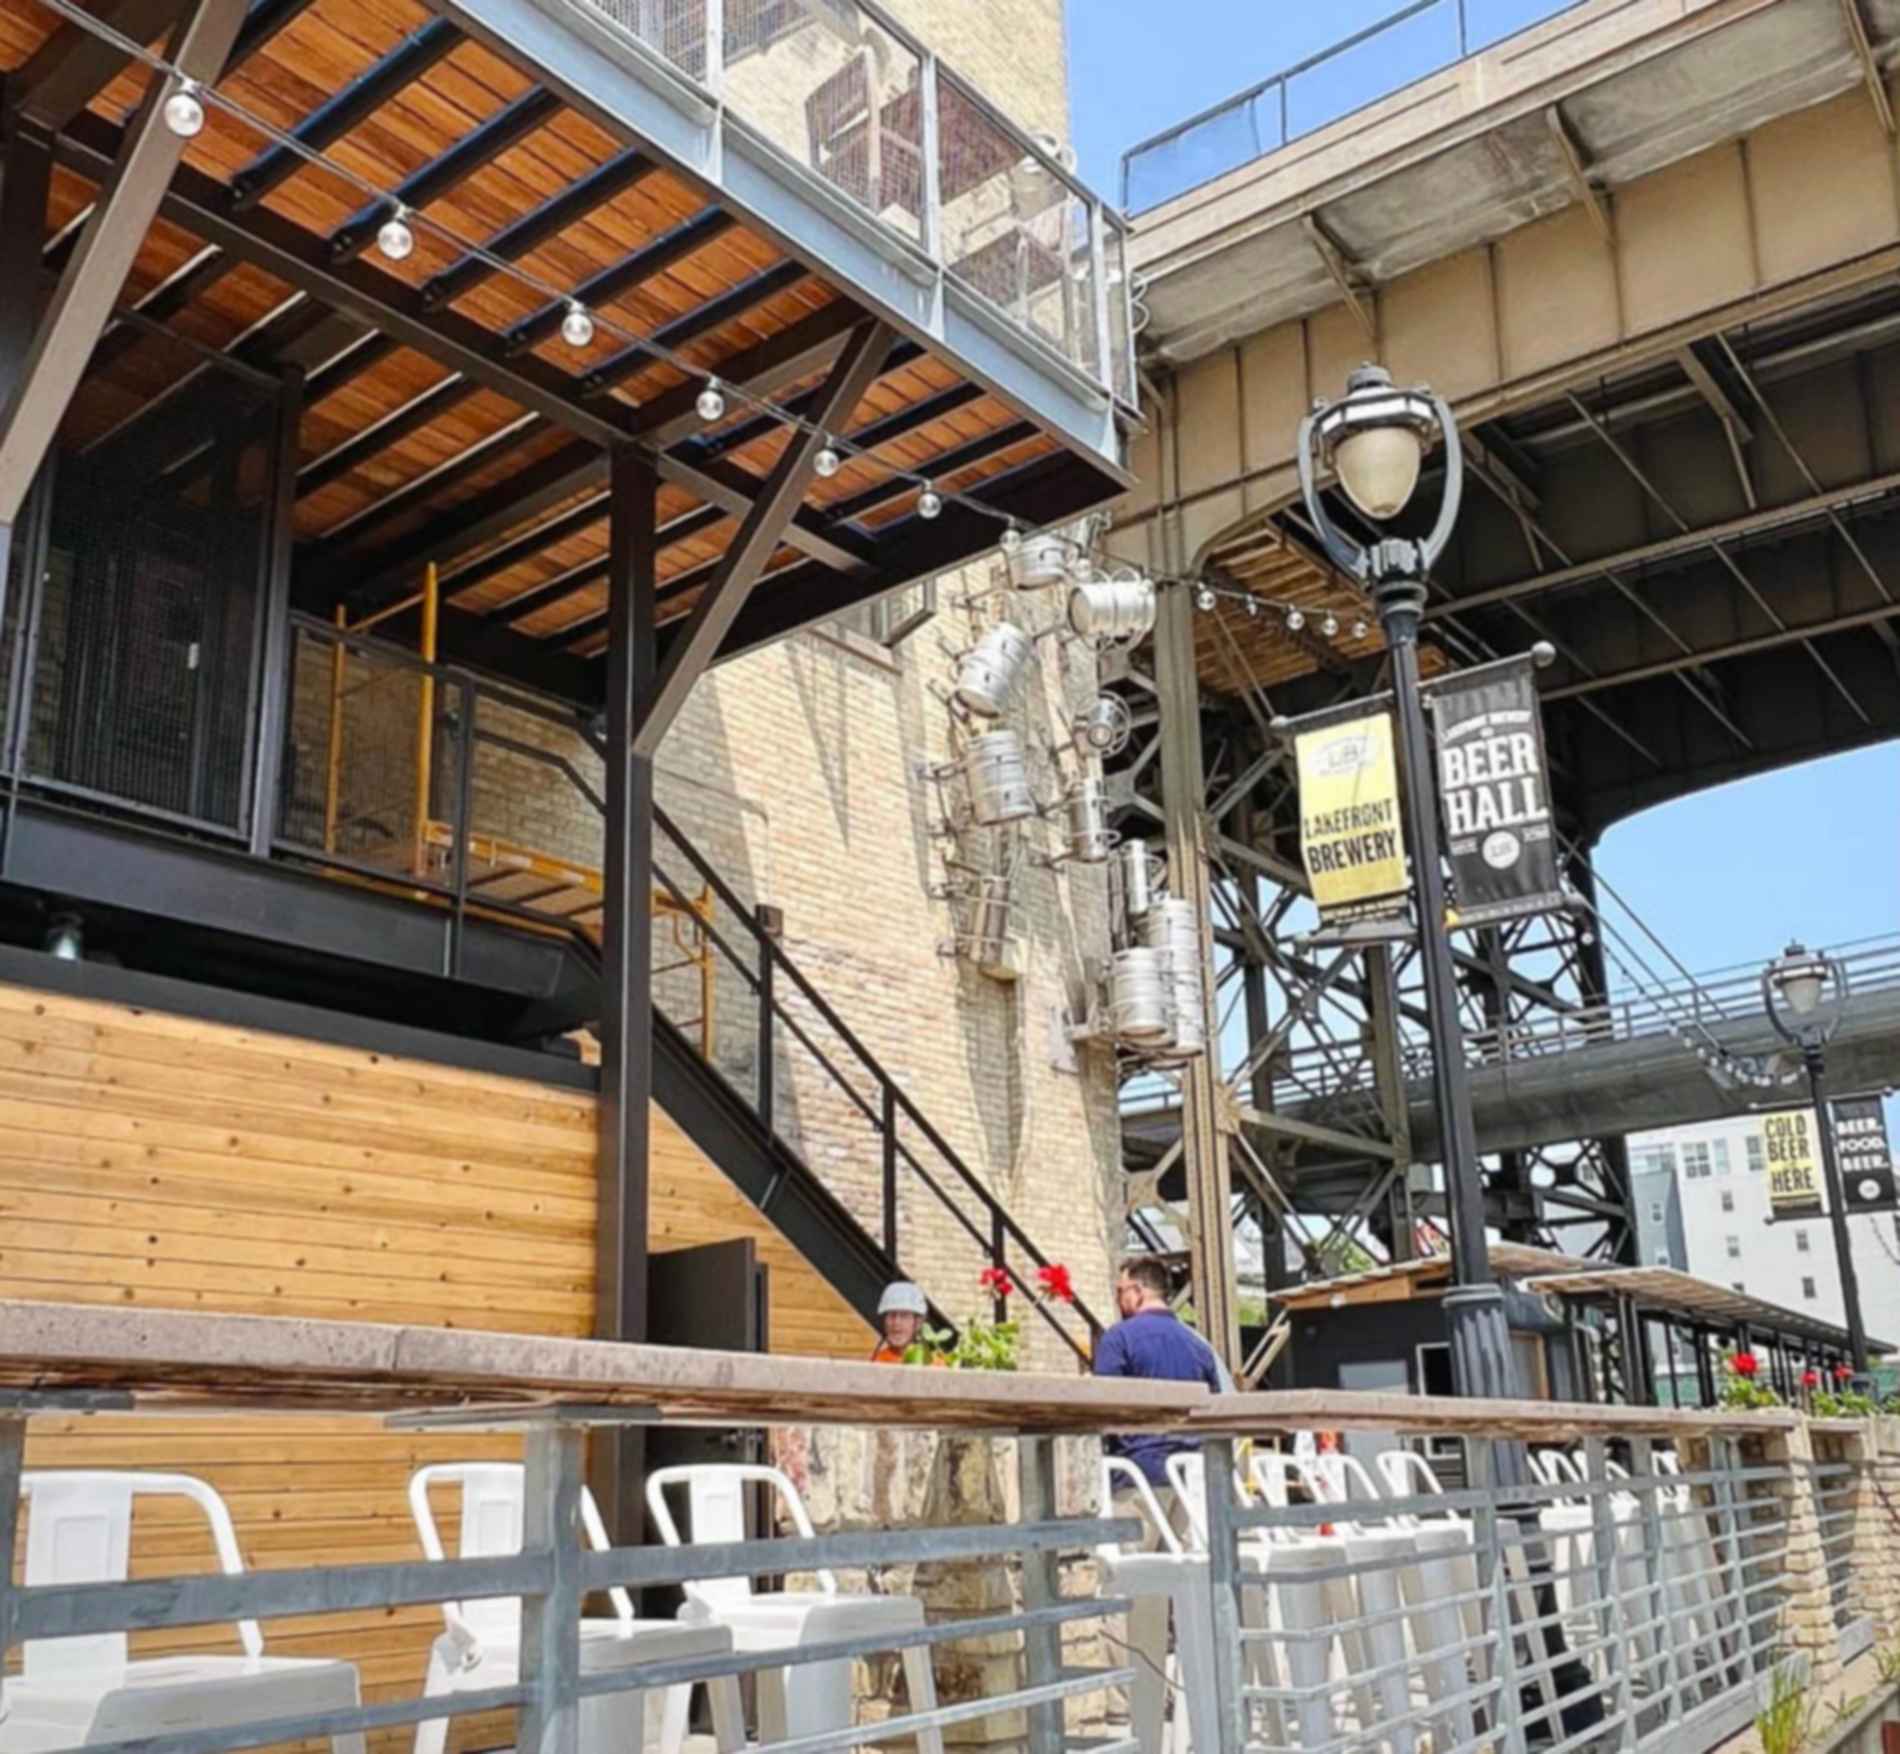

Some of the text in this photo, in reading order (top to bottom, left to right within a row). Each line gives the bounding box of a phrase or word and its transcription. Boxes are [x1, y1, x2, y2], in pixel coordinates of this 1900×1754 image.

[1442, 732, 1539, 788] BEER
[1303, 798, 1393, 839] LAKEFRONT
[1443, 777, 1549, 835] HALL
[1307, 829, 1397, 874] BREWERY
[1764, 1114, 1807, 1138] COLD
[1767, 1138, 1811, 1162] BEER
[1771, 1167, 1815, 1192] HERE
